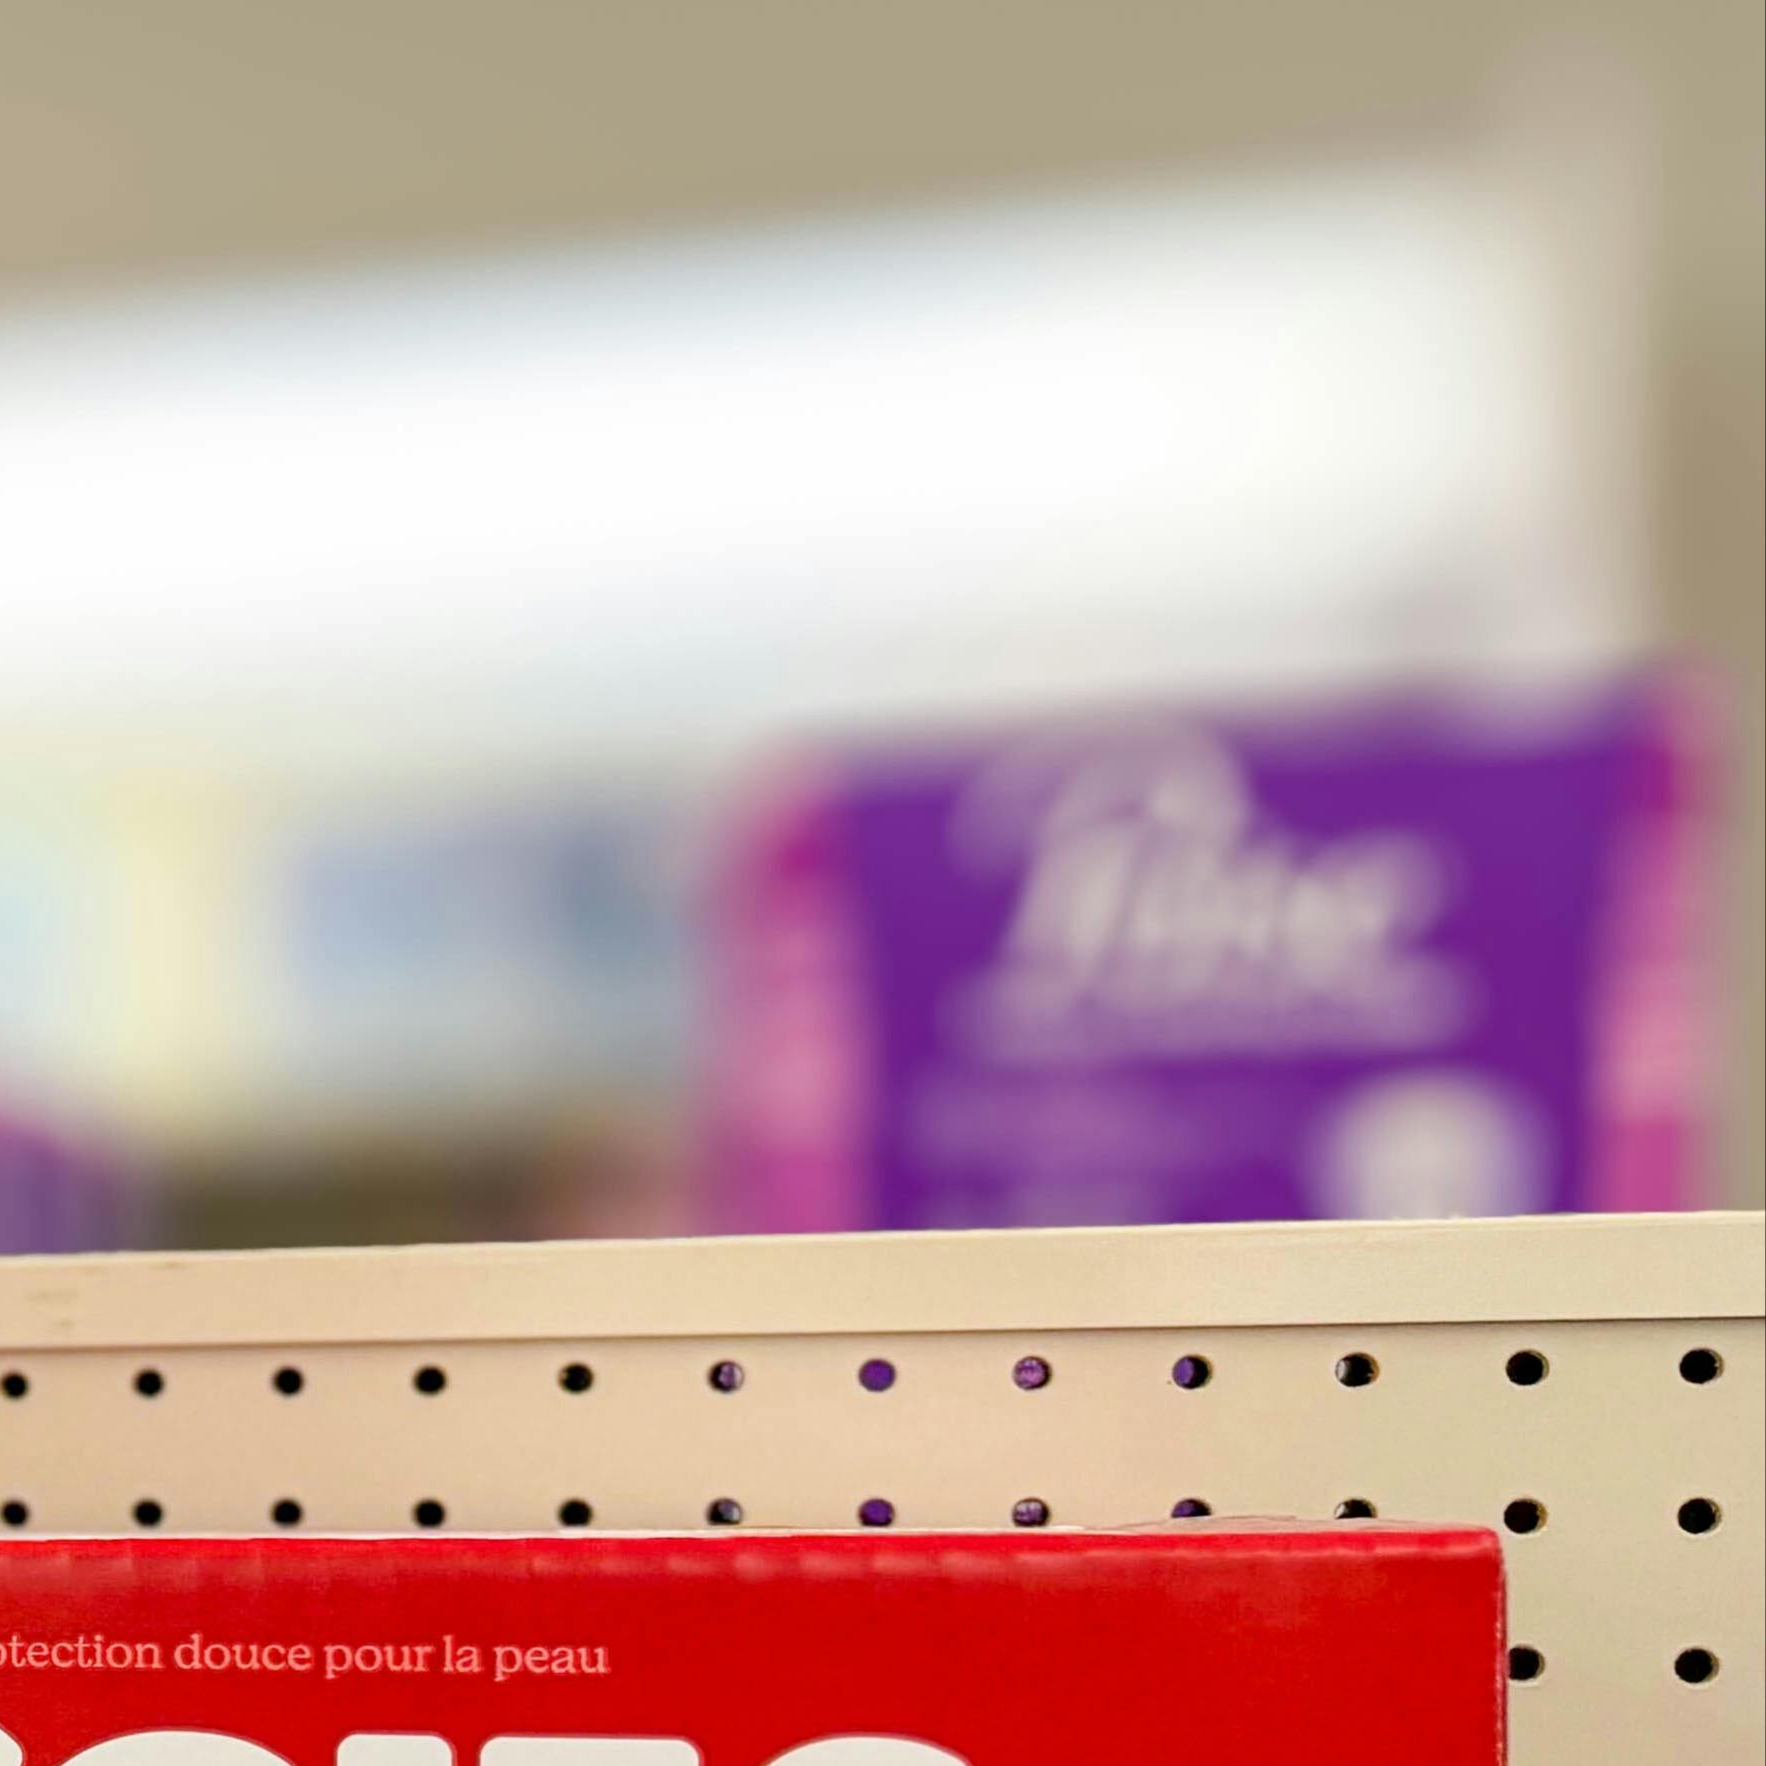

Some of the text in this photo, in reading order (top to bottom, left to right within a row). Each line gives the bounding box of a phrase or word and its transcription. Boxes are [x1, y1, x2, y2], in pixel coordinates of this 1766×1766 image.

[174, 1633, 311, 1670] douce
[324, 1645, 433, 1679] pour
[443, 1635, 481, 1672] la
[494, 1646, 607, 1681] peau
